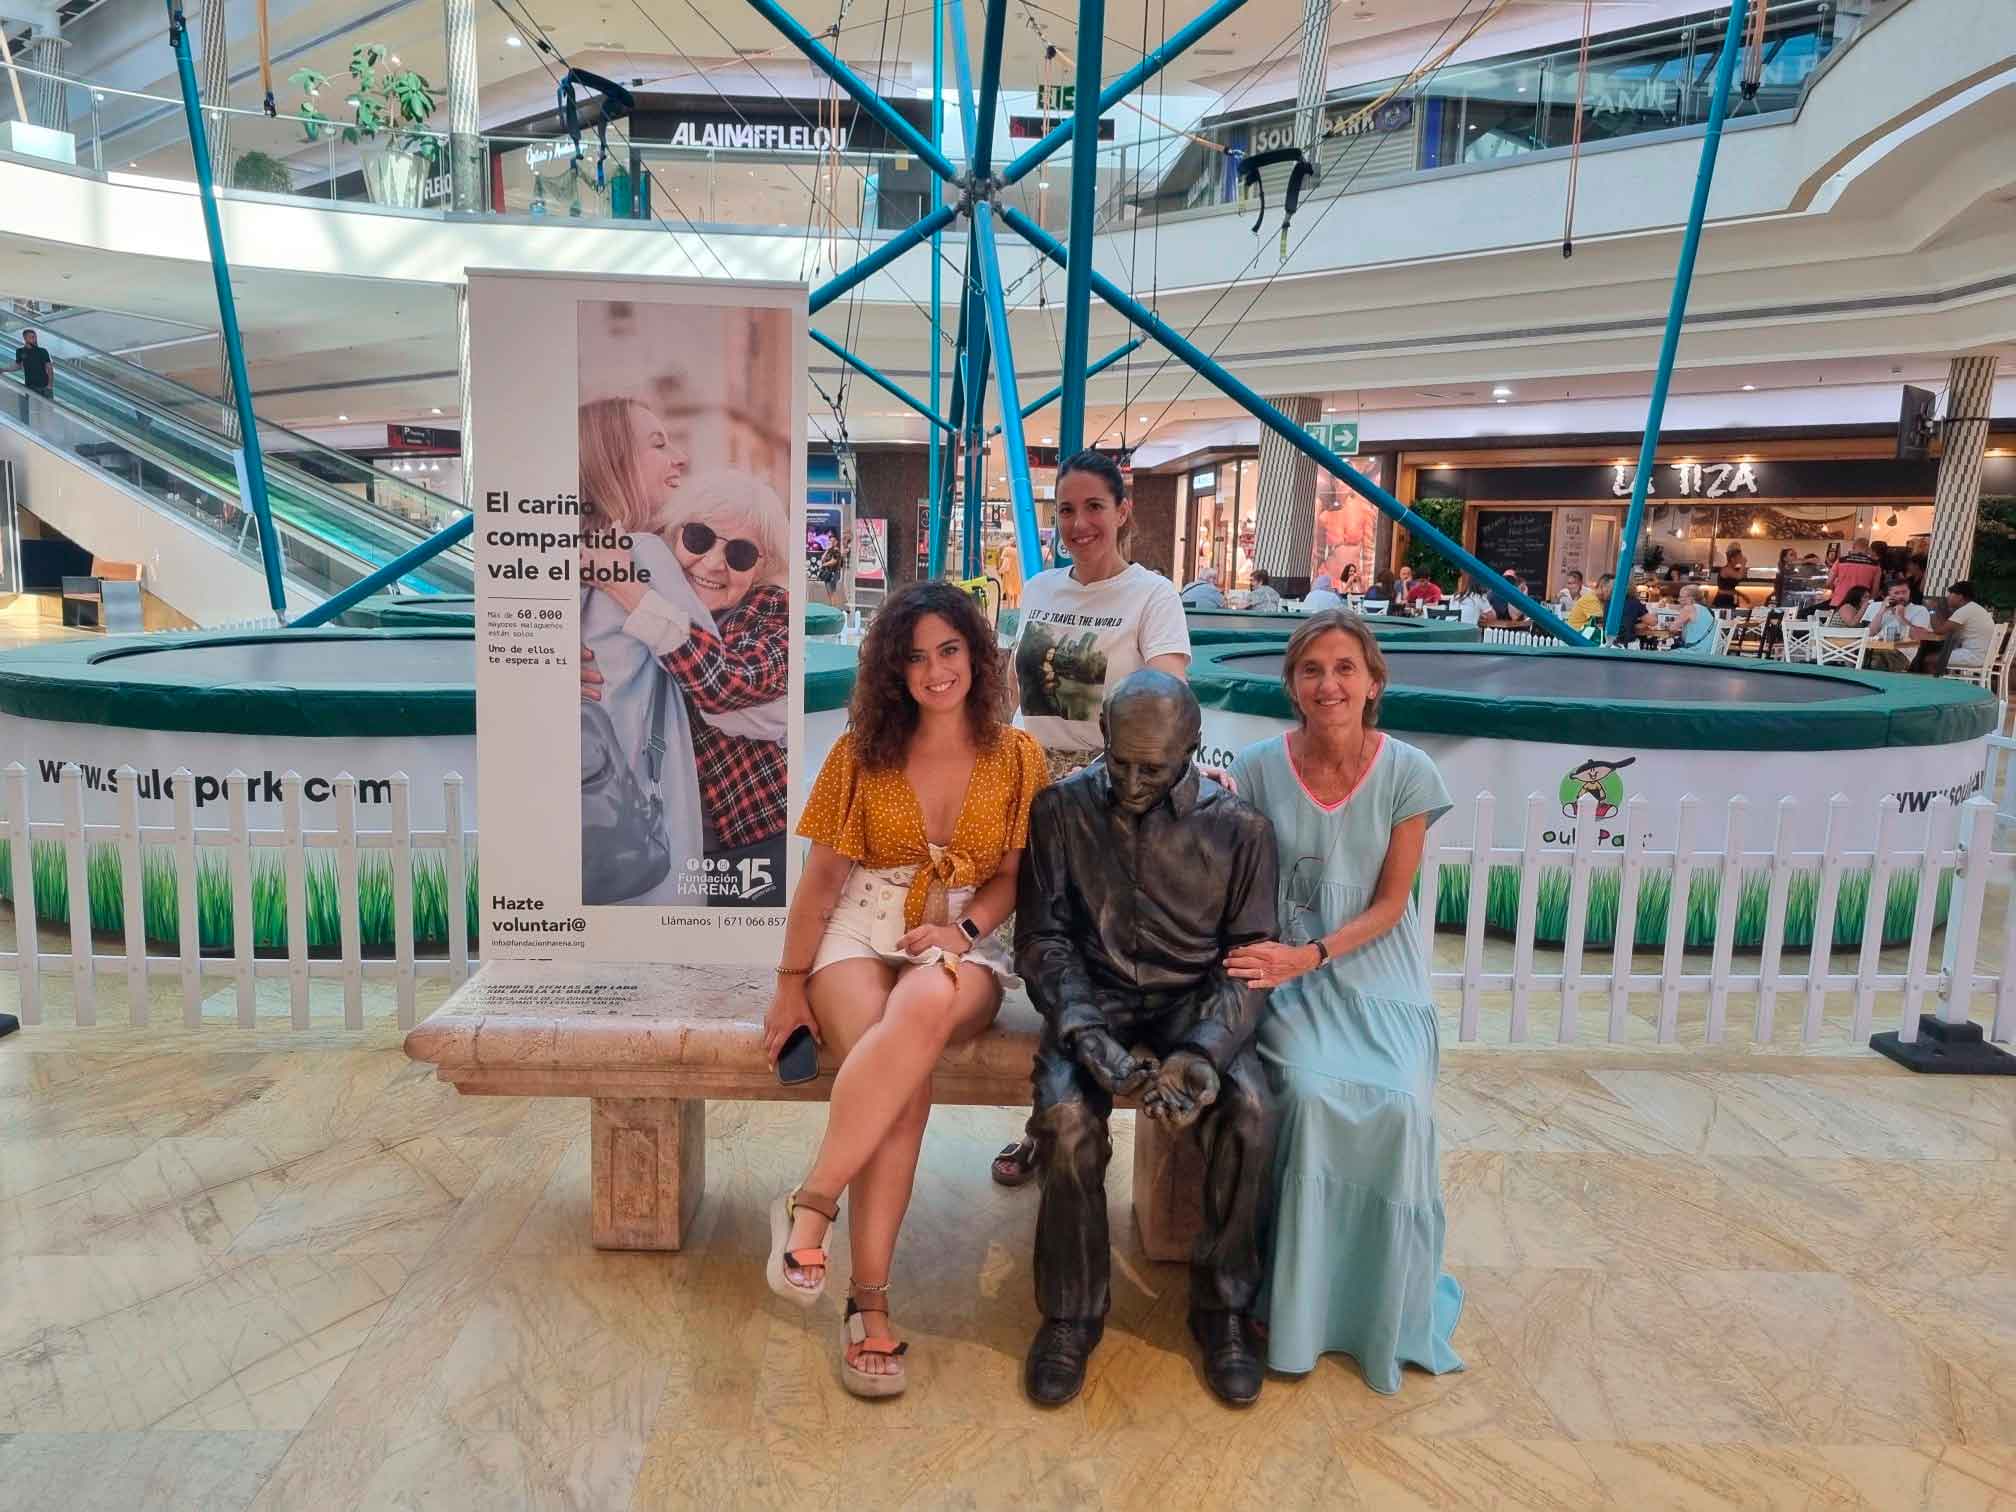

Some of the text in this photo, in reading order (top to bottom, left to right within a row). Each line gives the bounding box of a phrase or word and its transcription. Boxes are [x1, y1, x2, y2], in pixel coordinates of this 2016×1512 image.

[1671, 463, 1758, 499] TIZA
[486, 491, 597, 516] El cariño
[486, 528, 634, 553] compartido
[488, 558, 651, 583] vale el doble
[517, 609, 562, 620] 60.000
[1050, 612, 1077, 626] TRAVEL
[1078, 616, 1093, 627] THE
[1094, 618, 1123, 627] WORLD
[488, 644, 555, 654] Uno de ellos
[489, 656, 501, 664] te
[505, 657, 539, 666] espera
[678, 858, 774, 893] Fundación 15
[678, 884, 740, 896] HARENA
[492, 896, 545, 910] Hazte
[492, 917, 586, 932] voluntari@
[661, 916, 786, 927] Llámanos 671 066 857
